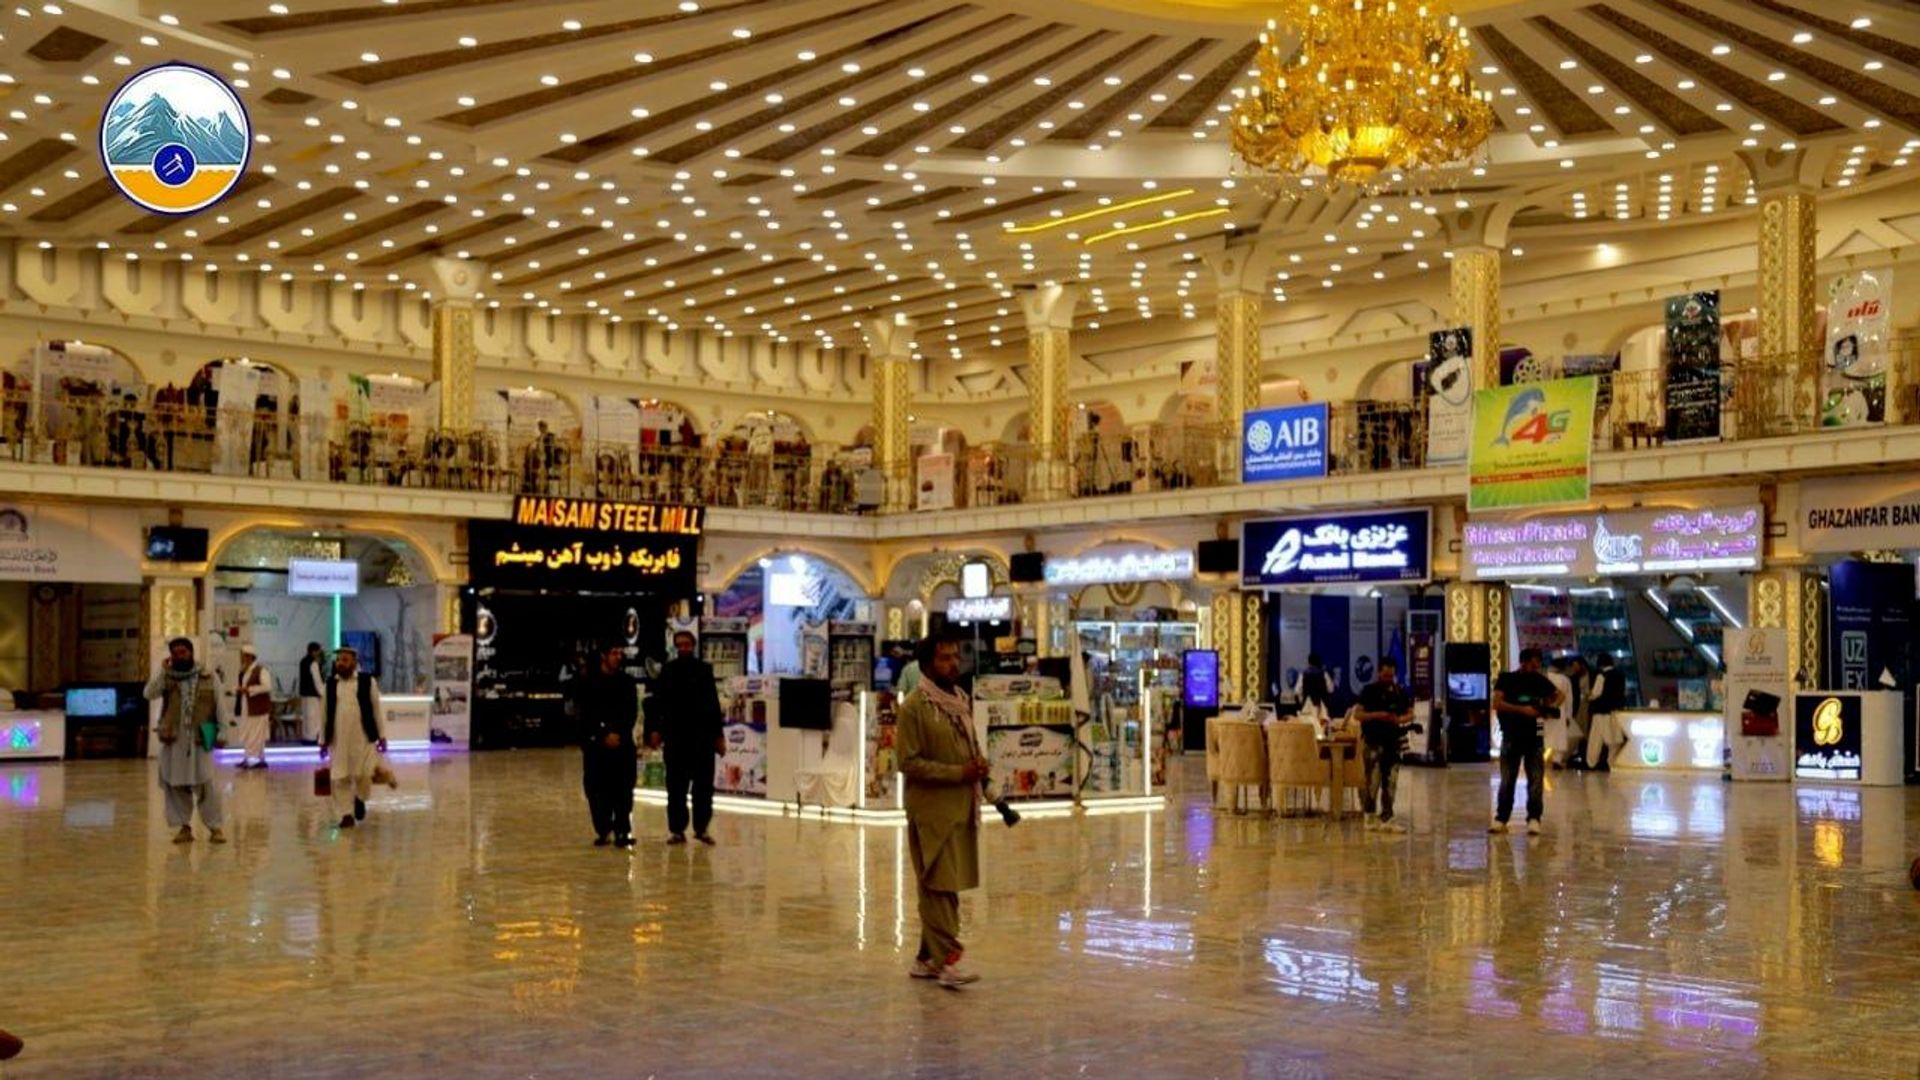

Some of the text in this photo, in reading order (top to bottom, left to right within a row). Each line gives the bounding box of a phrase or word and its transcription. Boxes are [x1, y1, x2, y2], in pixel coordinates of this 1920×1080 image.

[1274, 417, 1320, 450] AIB
[1511, 409, 1571, 444] 4G
[517, 497, 701, 535] MAISAM STEEL MILL
[1808, 506, 1889, 530] GHAZANFAR
[547, 542, 584, 569] آهن
[586, 544, 624, 571] ذوب
[1843, 637, 1866, 664] UZ
